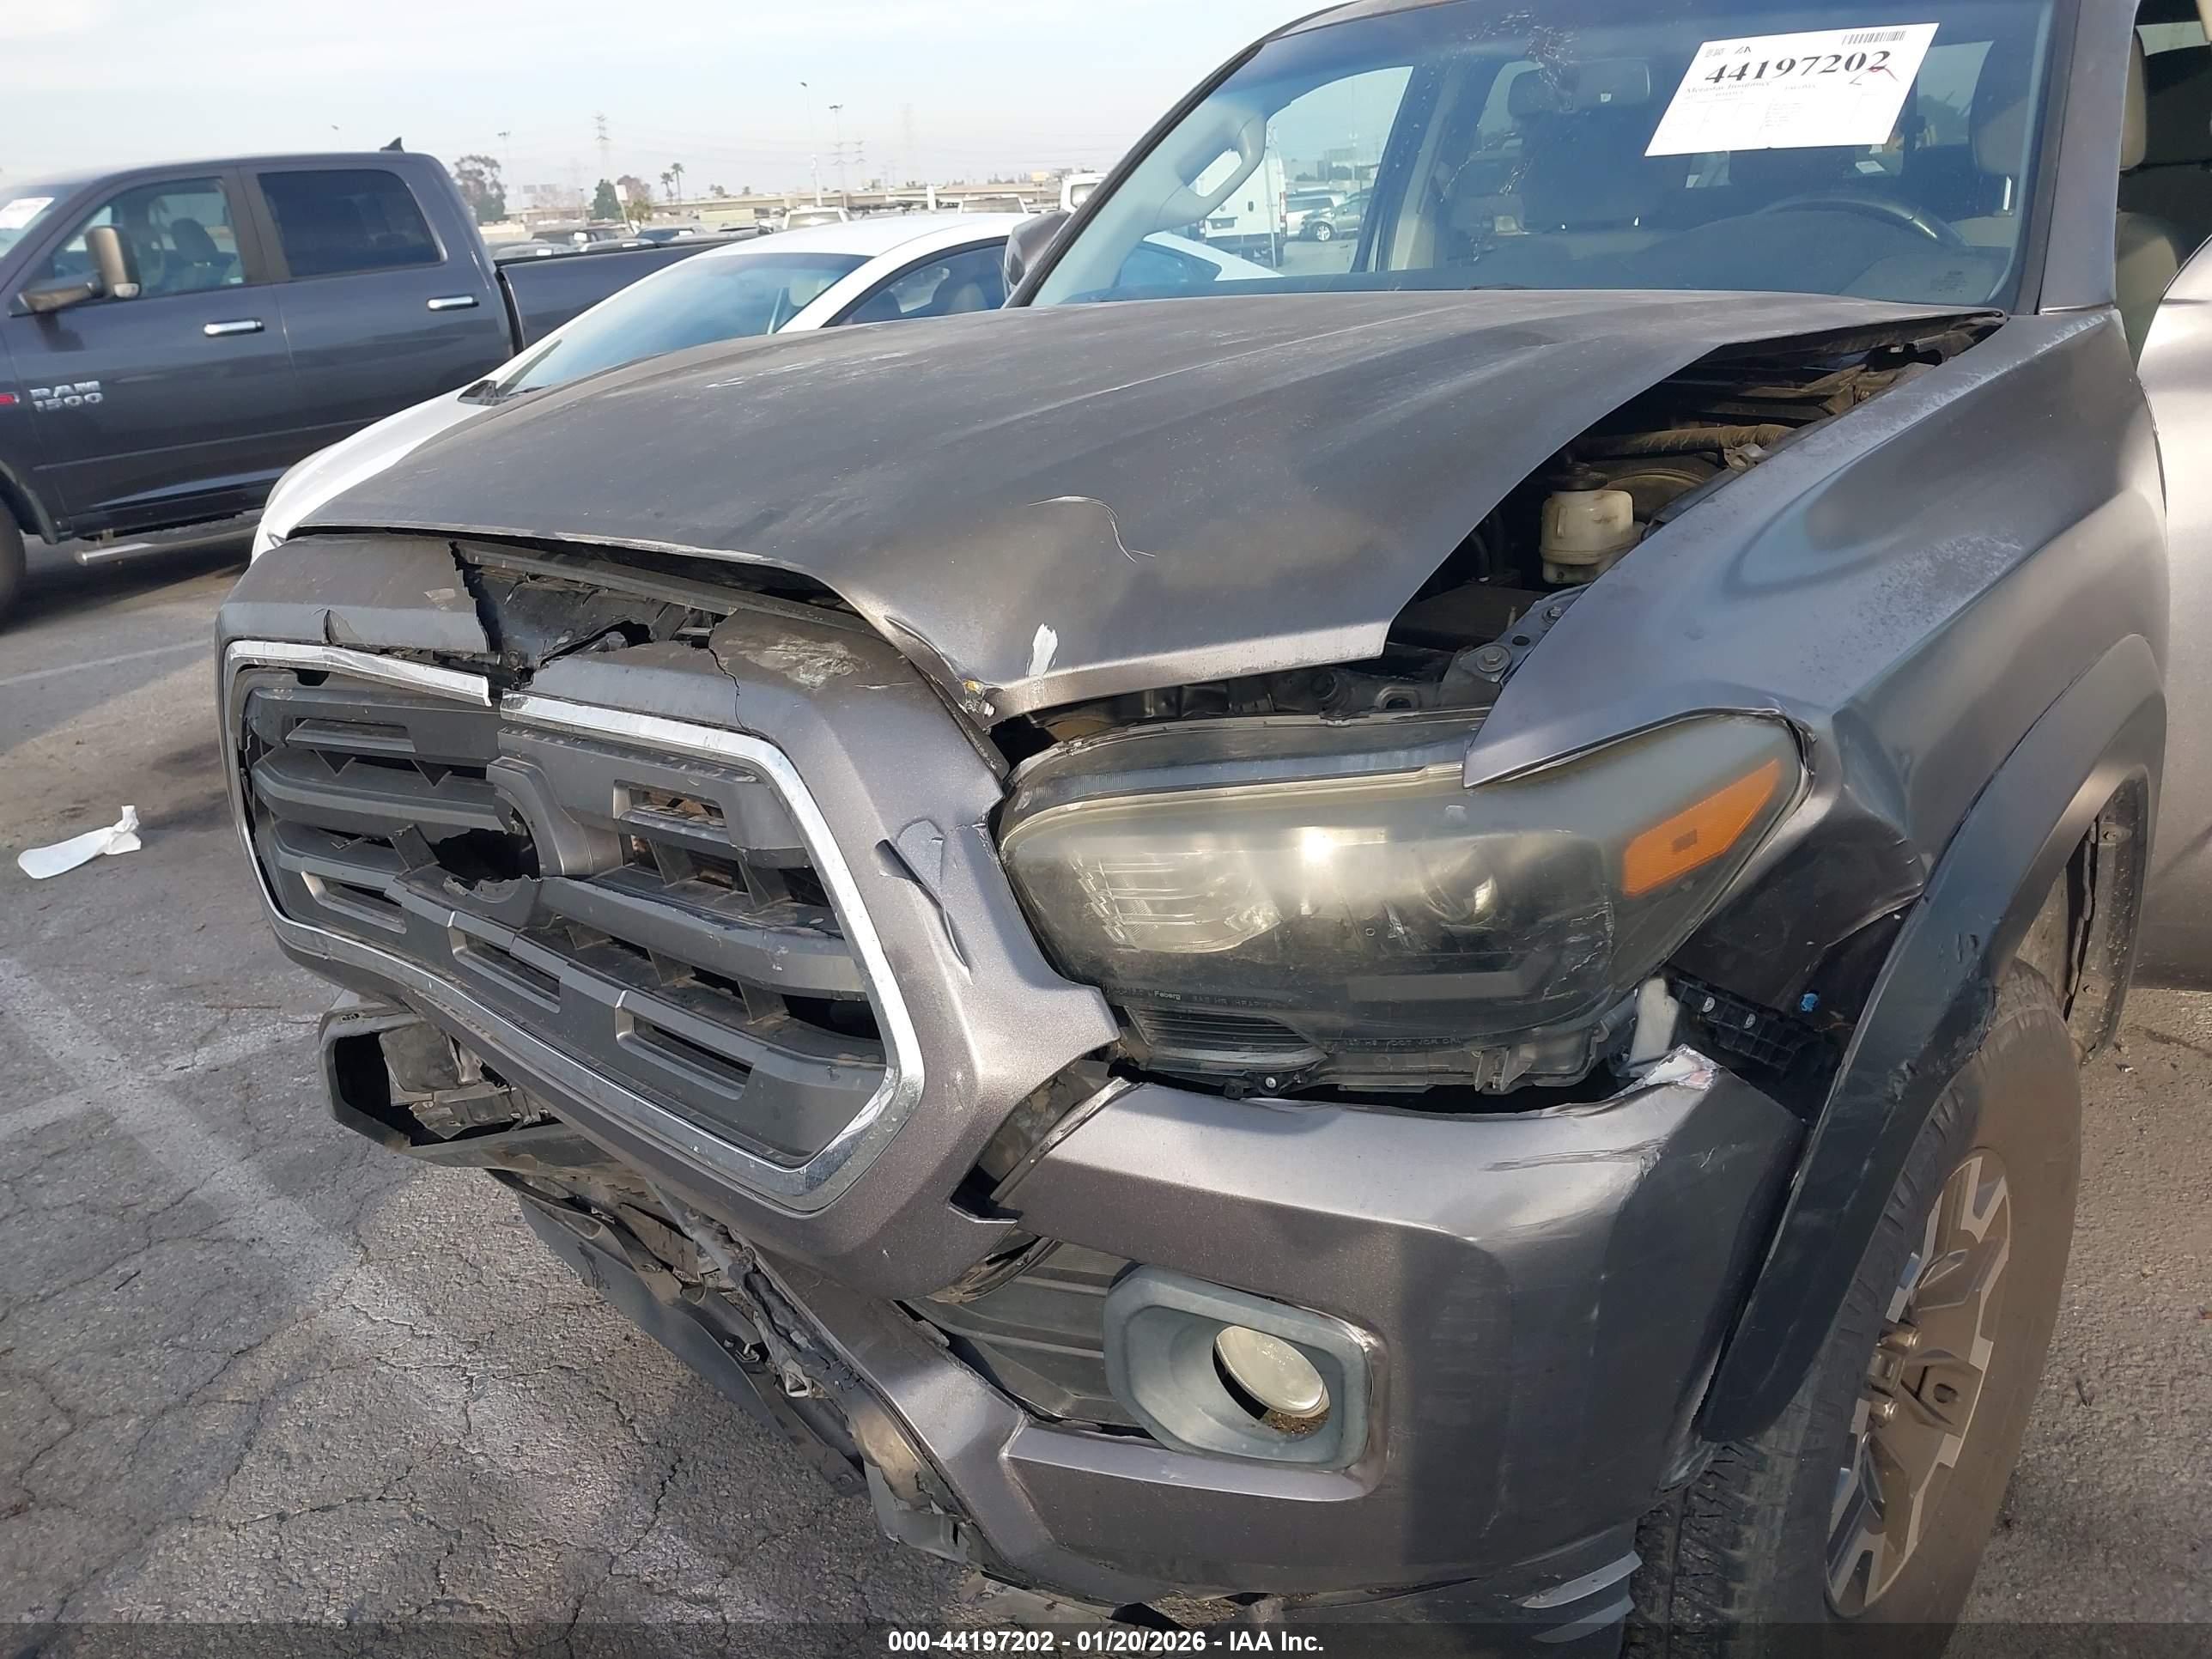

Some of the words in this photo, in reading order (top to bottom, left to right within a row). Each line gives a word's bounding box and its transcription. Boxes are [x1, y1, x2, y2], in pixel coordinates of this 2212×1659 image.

[1705, 50, 1891, 85] 44197202
[29, 380, 100, 398] RAM
[33, 392, 103, 412] 1500
